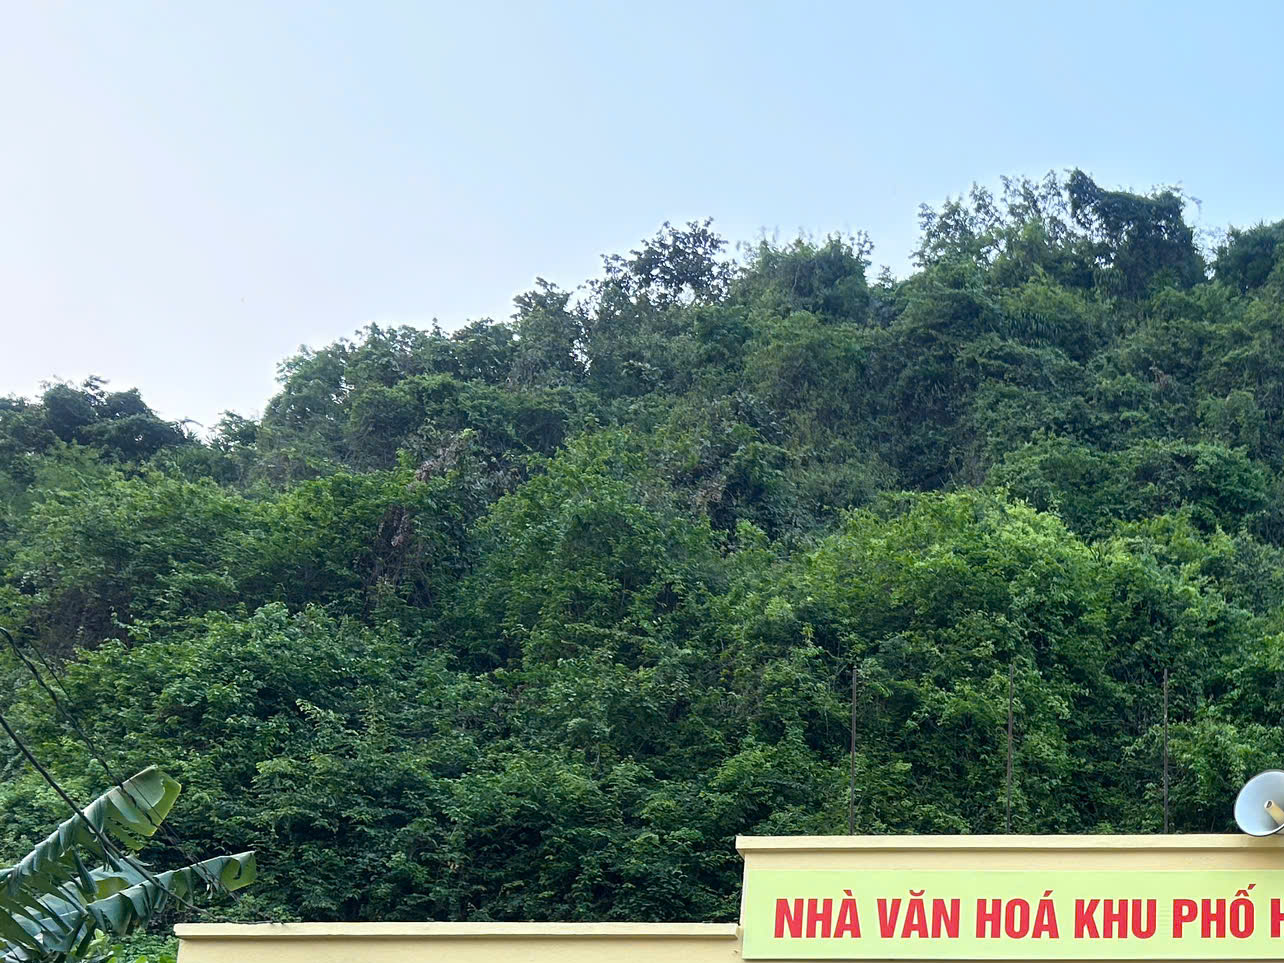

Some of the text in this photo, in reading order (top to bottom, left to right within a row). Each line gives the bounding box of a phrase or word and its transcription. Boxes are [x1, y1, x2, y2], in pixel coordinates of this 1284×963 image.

[774, 889, 861, 938] NHÀ
[877, 889, 961, 938] VĂN
[975, 890, 1060, 938] HOÁ
[1074, 898, 1157, 939] KHU
[1172, 883, 1255, 938] PHỐ
